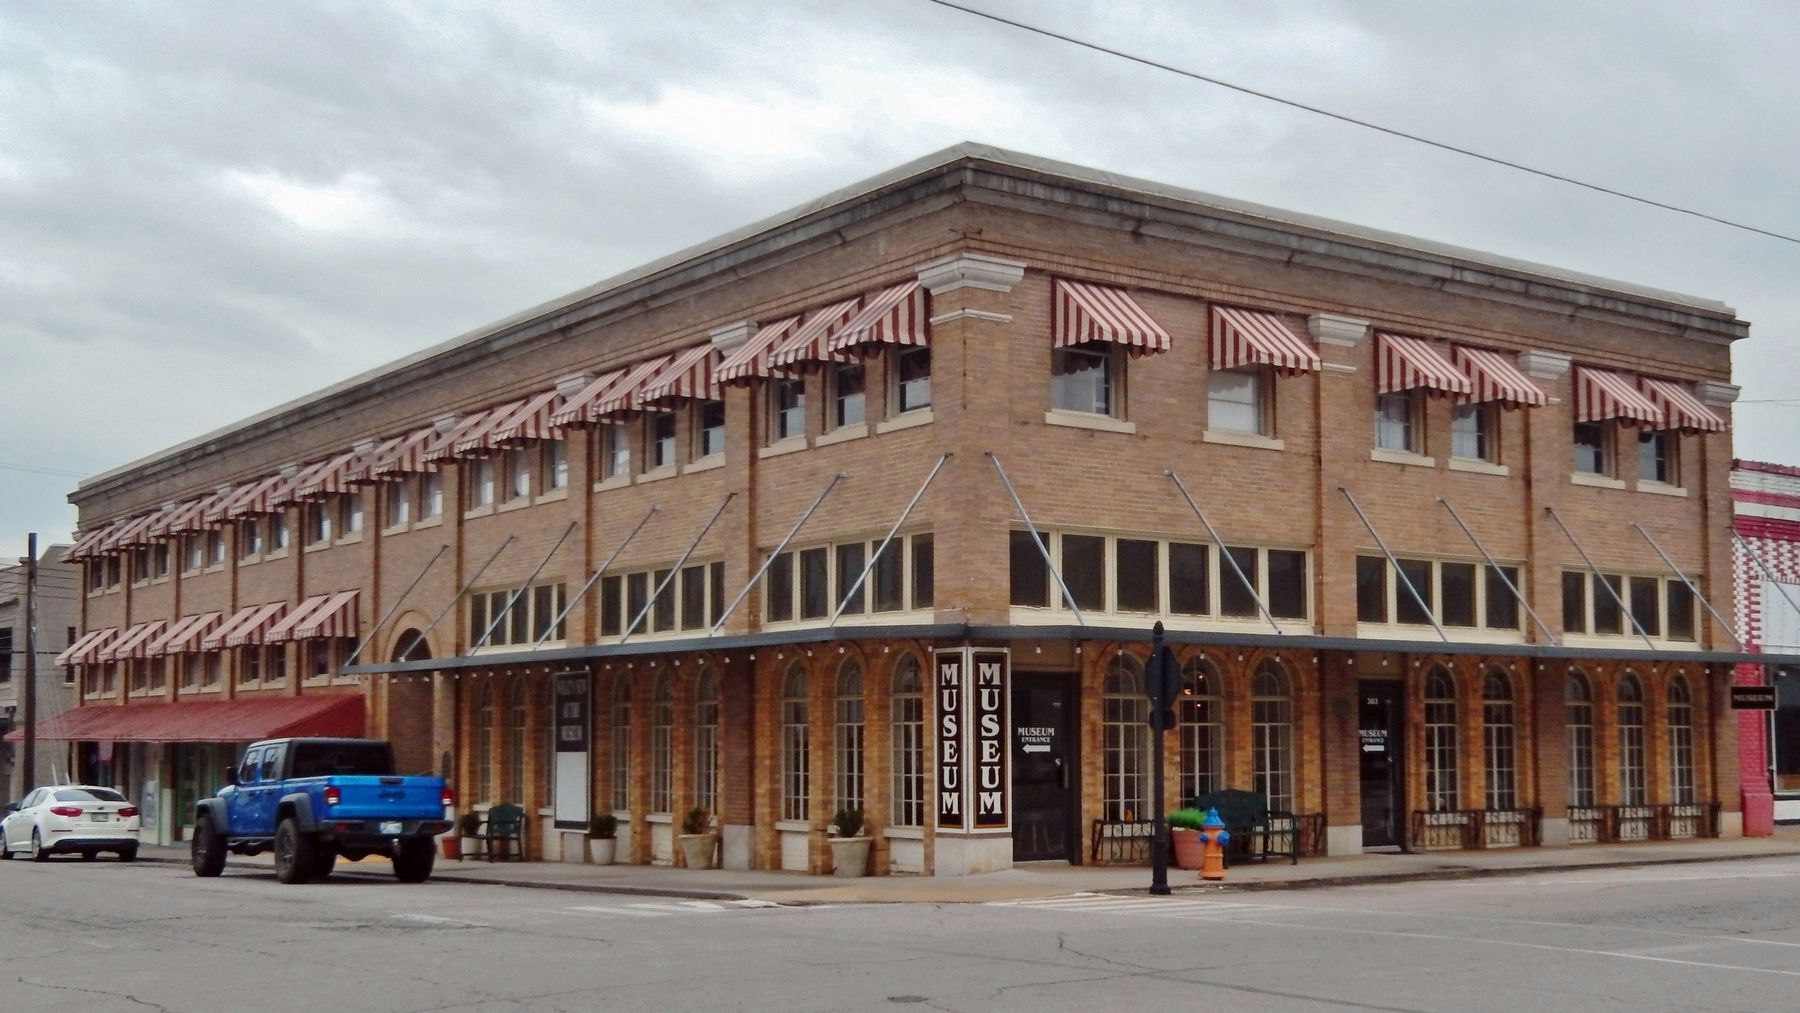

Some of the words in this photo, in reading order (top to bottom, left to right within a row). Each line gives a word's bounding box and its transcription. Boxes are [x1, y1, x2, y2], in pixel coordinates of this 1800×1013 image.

[941, 663, 959, 814] MUSEUM
[978, 663, 1002, 814] MUSEUM
[1017, 727, 1055, 736] MUSEUM
